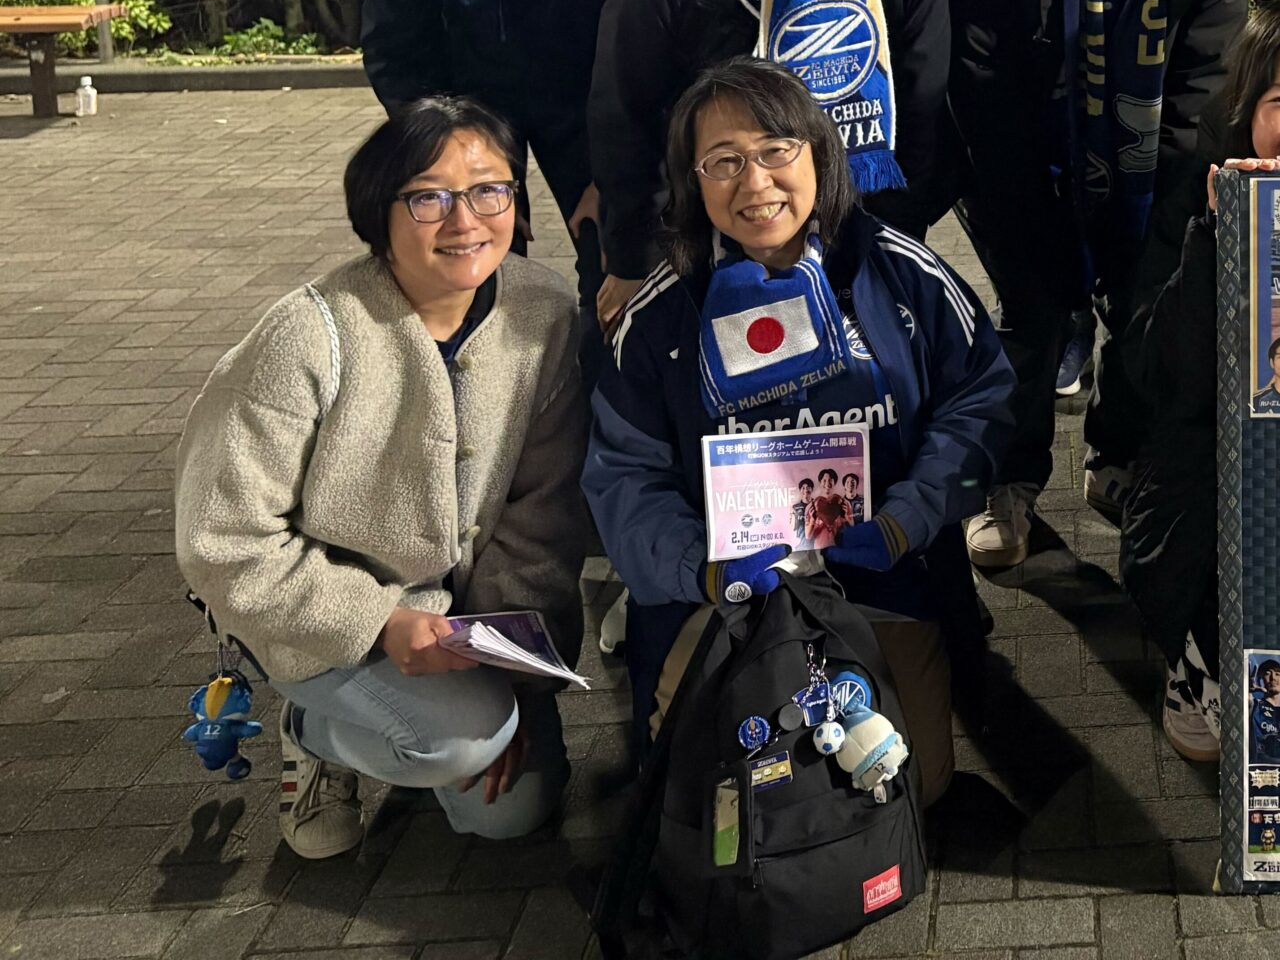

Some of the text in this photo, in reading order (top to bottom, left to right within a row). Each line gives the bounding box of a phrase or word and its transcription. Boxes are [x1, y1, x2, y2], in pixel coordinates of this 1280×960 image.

[823, 54, 860, 69] MACHIDA
[793, 62, 862, 81] ZELVIA
[718, 359, 847, 417] FC MACHIDA ZELVIA
[716, 437, 857, 455] 百年構想リーグホームゲーム開幕戦
[731, 531, 749, 544] 2.14
[204, 724, 221, 736] 12
[873, 762, 886, 775] 12
